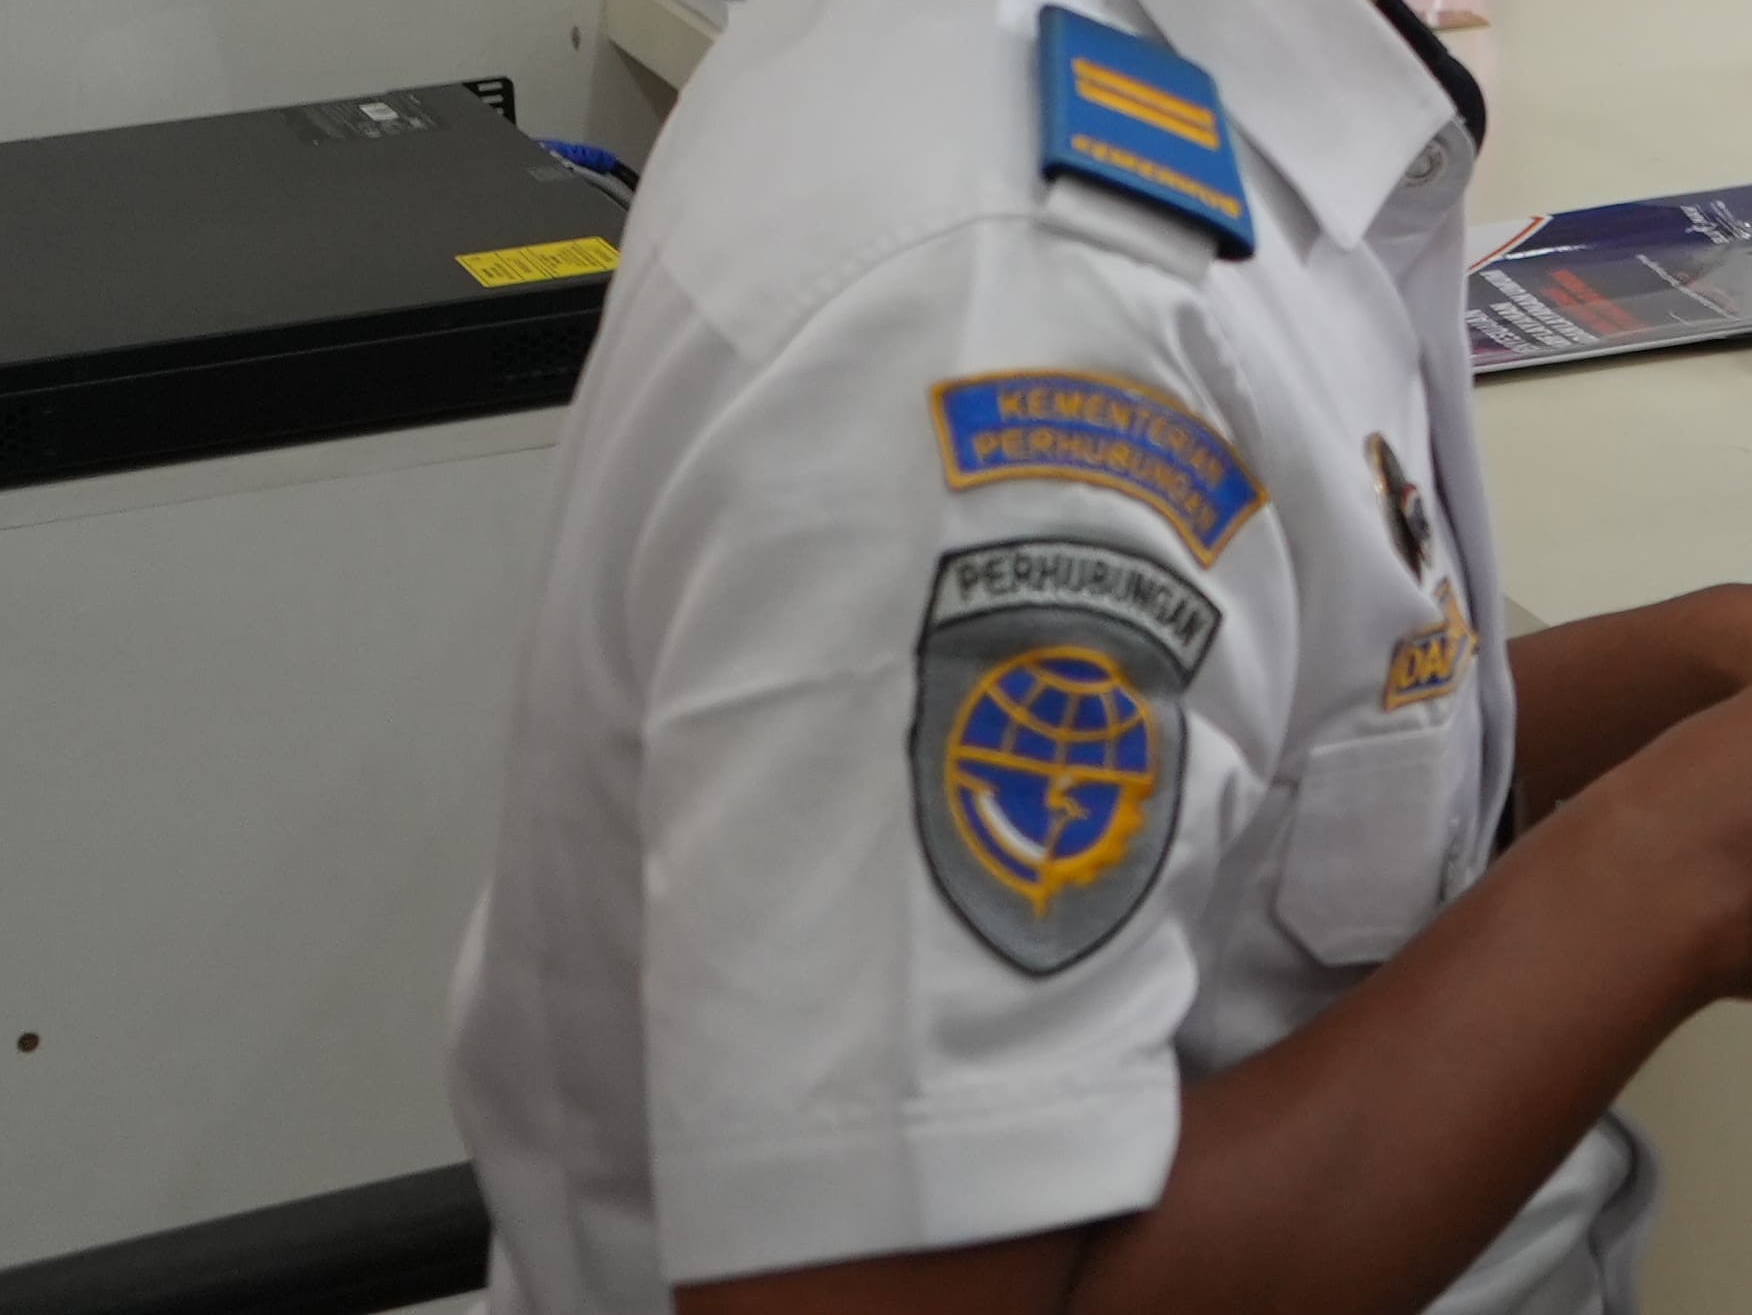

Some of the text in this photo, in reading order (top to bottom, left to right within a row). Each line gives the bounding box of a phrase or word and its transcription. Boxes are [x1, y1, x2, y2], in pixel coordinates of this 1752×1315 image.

[972, 428, 1219, 531] PERHUBUNGAN
[997, 389, 1226, 487] KEMENTERIAN
[956, 551, 1208, 646] PERHUBUNGAN
